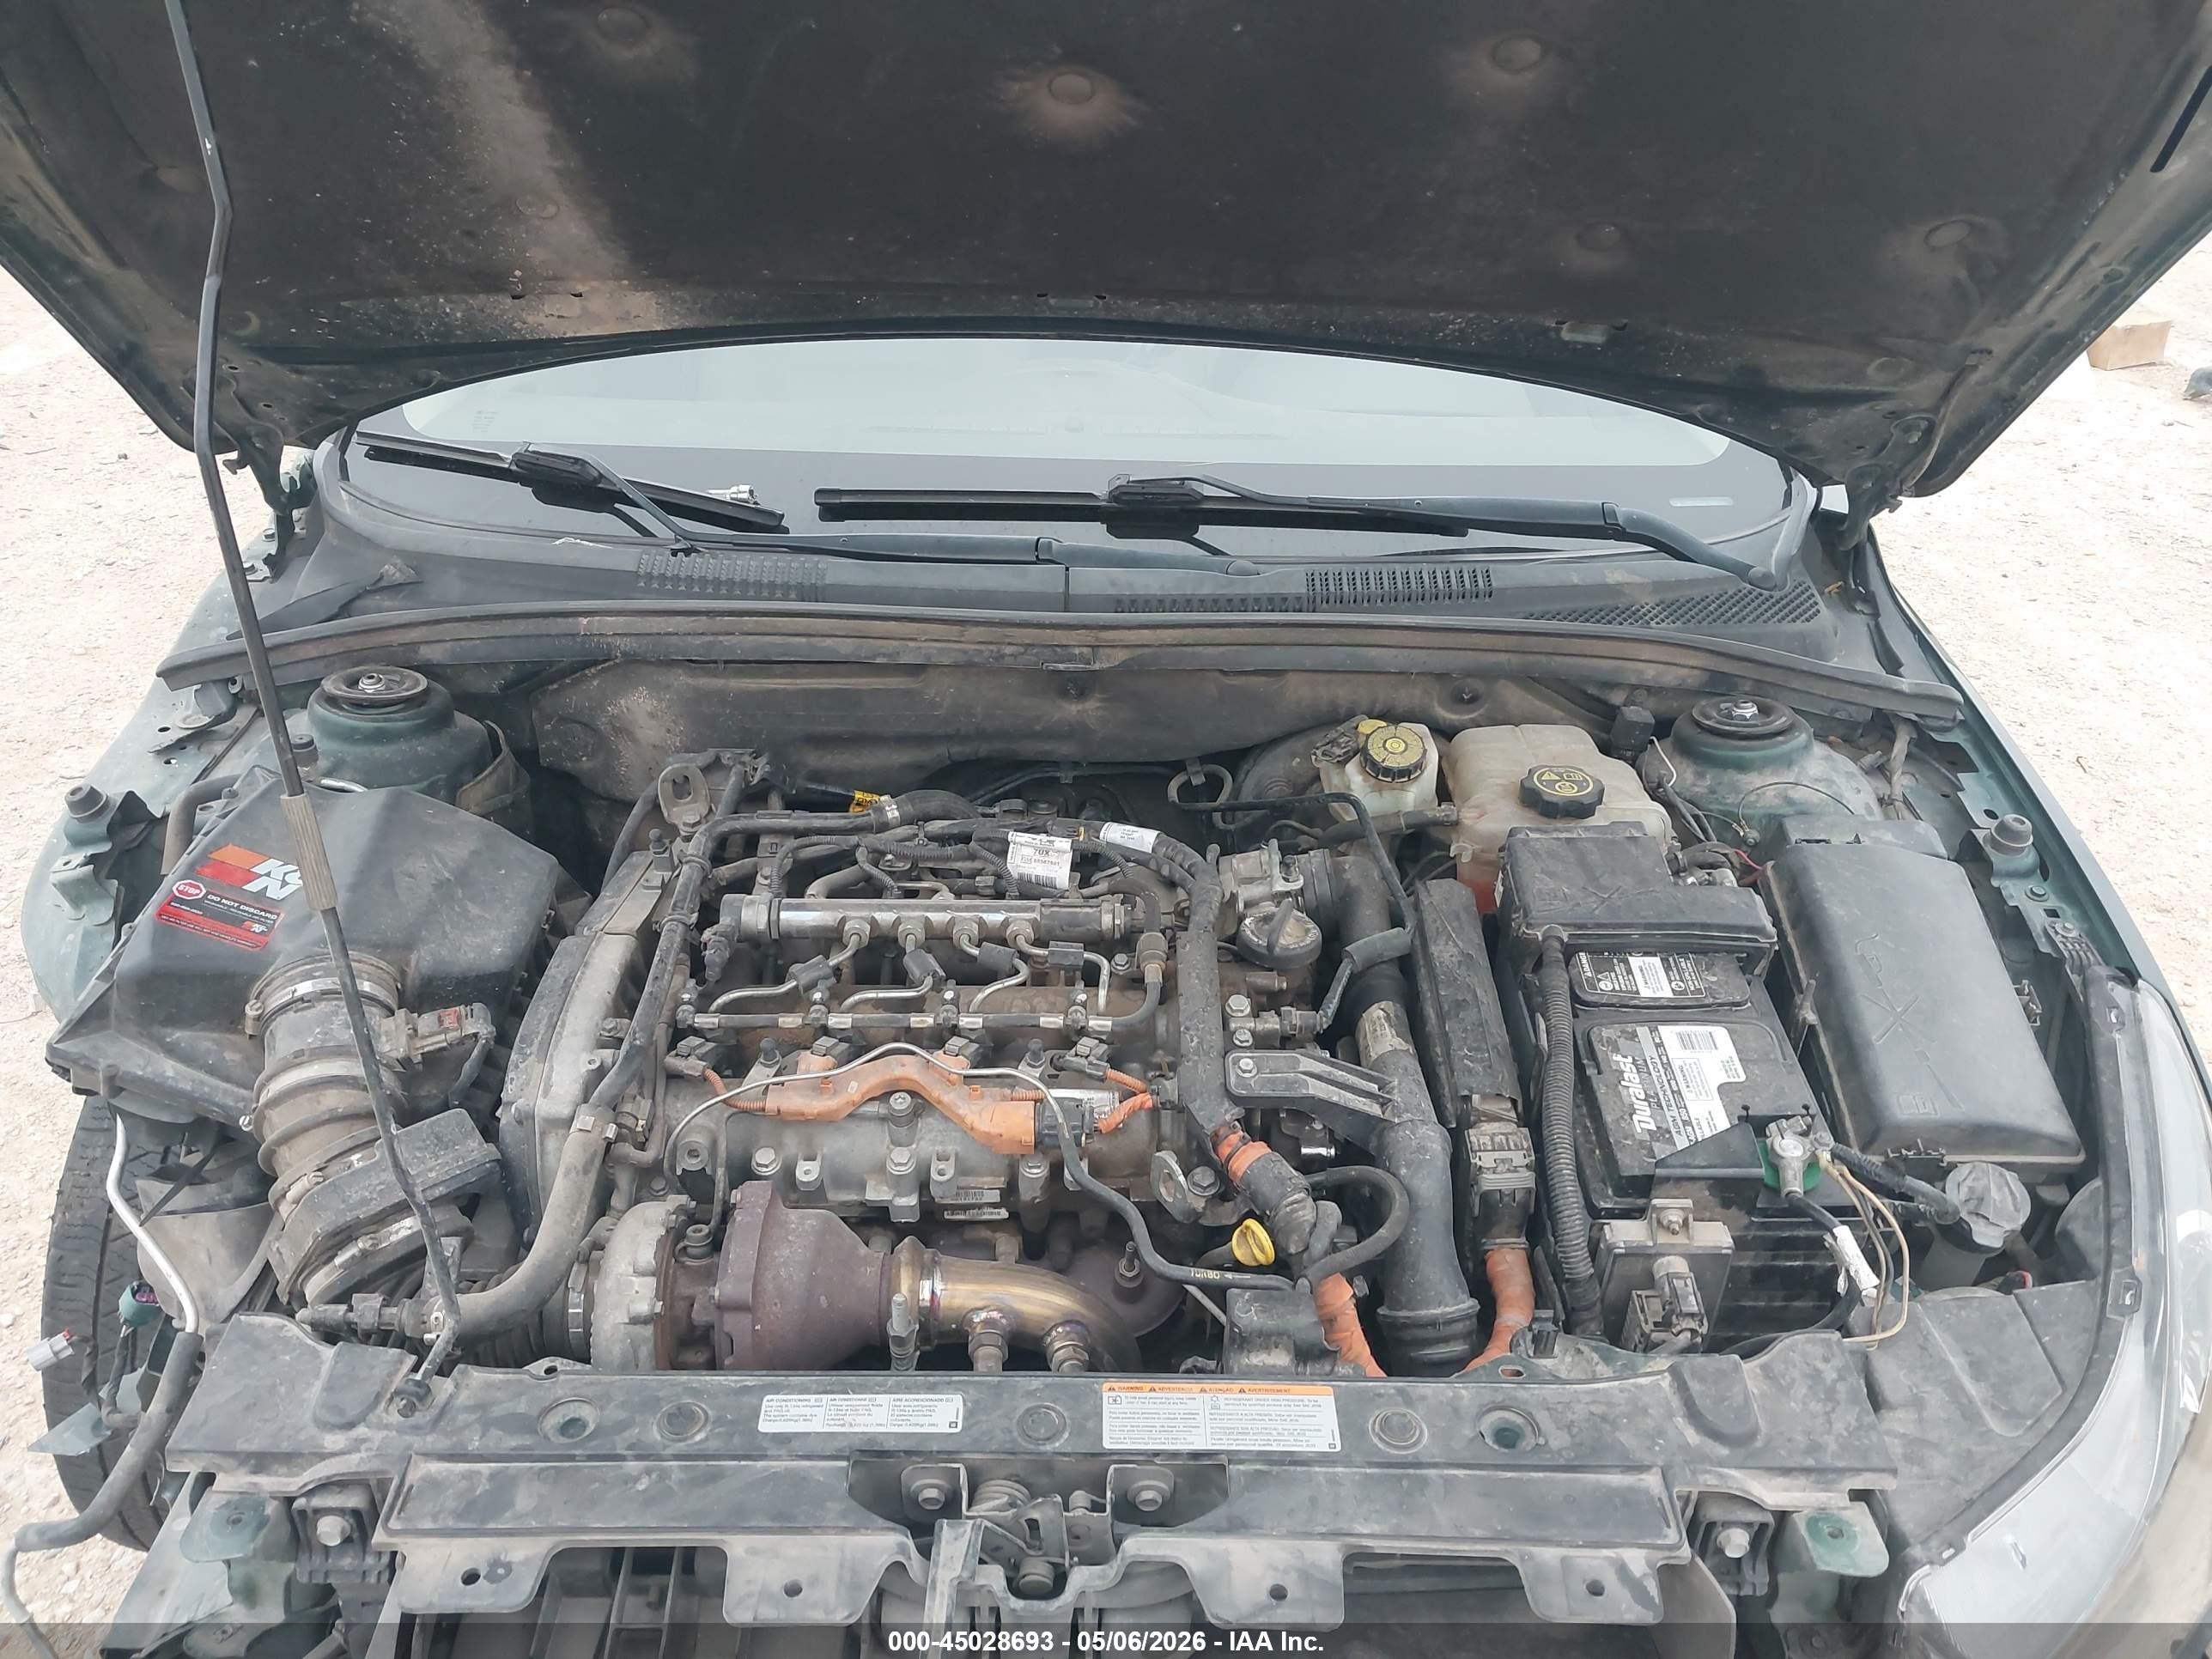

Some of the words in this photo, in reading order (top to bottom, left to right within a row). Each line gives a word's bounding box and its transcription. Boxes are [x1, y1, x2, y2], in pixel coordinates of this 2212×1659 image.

[177, 884, 201, 896] STOP
[207, 894, 221, 902] DO
[221, 897, 240, 908] NOT
[240, 904, 278, 921] DISCARD
[1613, 1053, 1657, 1133] Duralast
[1634, 1056, 1662, 1109] PLATINUM
[1648, 1054, 1674, 1112] TECHNOLOGY
[1669, 1115, 1683, 1137] AGM
[1189, 1268, 1221, 1279] TURBO
